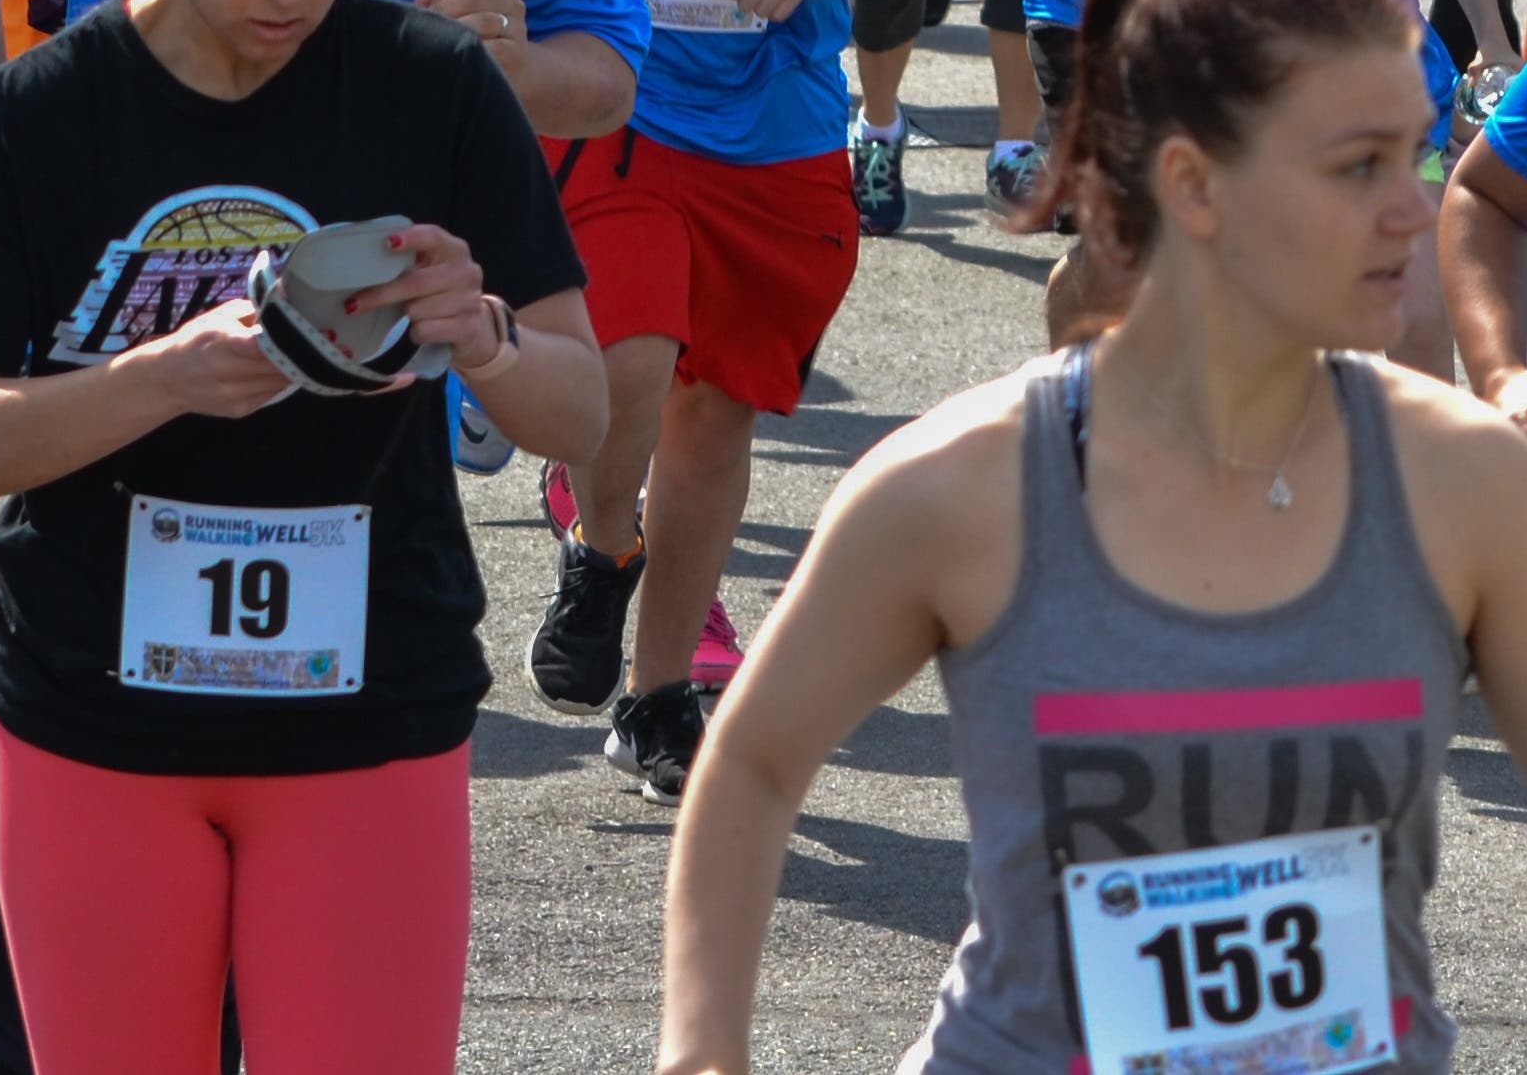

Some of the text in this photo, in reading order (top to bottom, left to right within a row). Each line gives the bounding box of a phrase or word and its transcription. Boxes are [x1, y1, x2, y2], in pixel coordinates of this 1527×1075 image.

[173, 245, 235, 266] LOS
[184, 529, 256, 546] WALKING
[185, 515, 254, 533] RUNNING
[256, 524, 311, 544] WELL
[198, 558, 290, 641] 19
[1038, 730, 1432, 877] RUN
[1143, 862, 1233, 889] RUNNING
[1236, 854, 1306, 891] WELL
[1137, 900, 1326, 1033] 153
